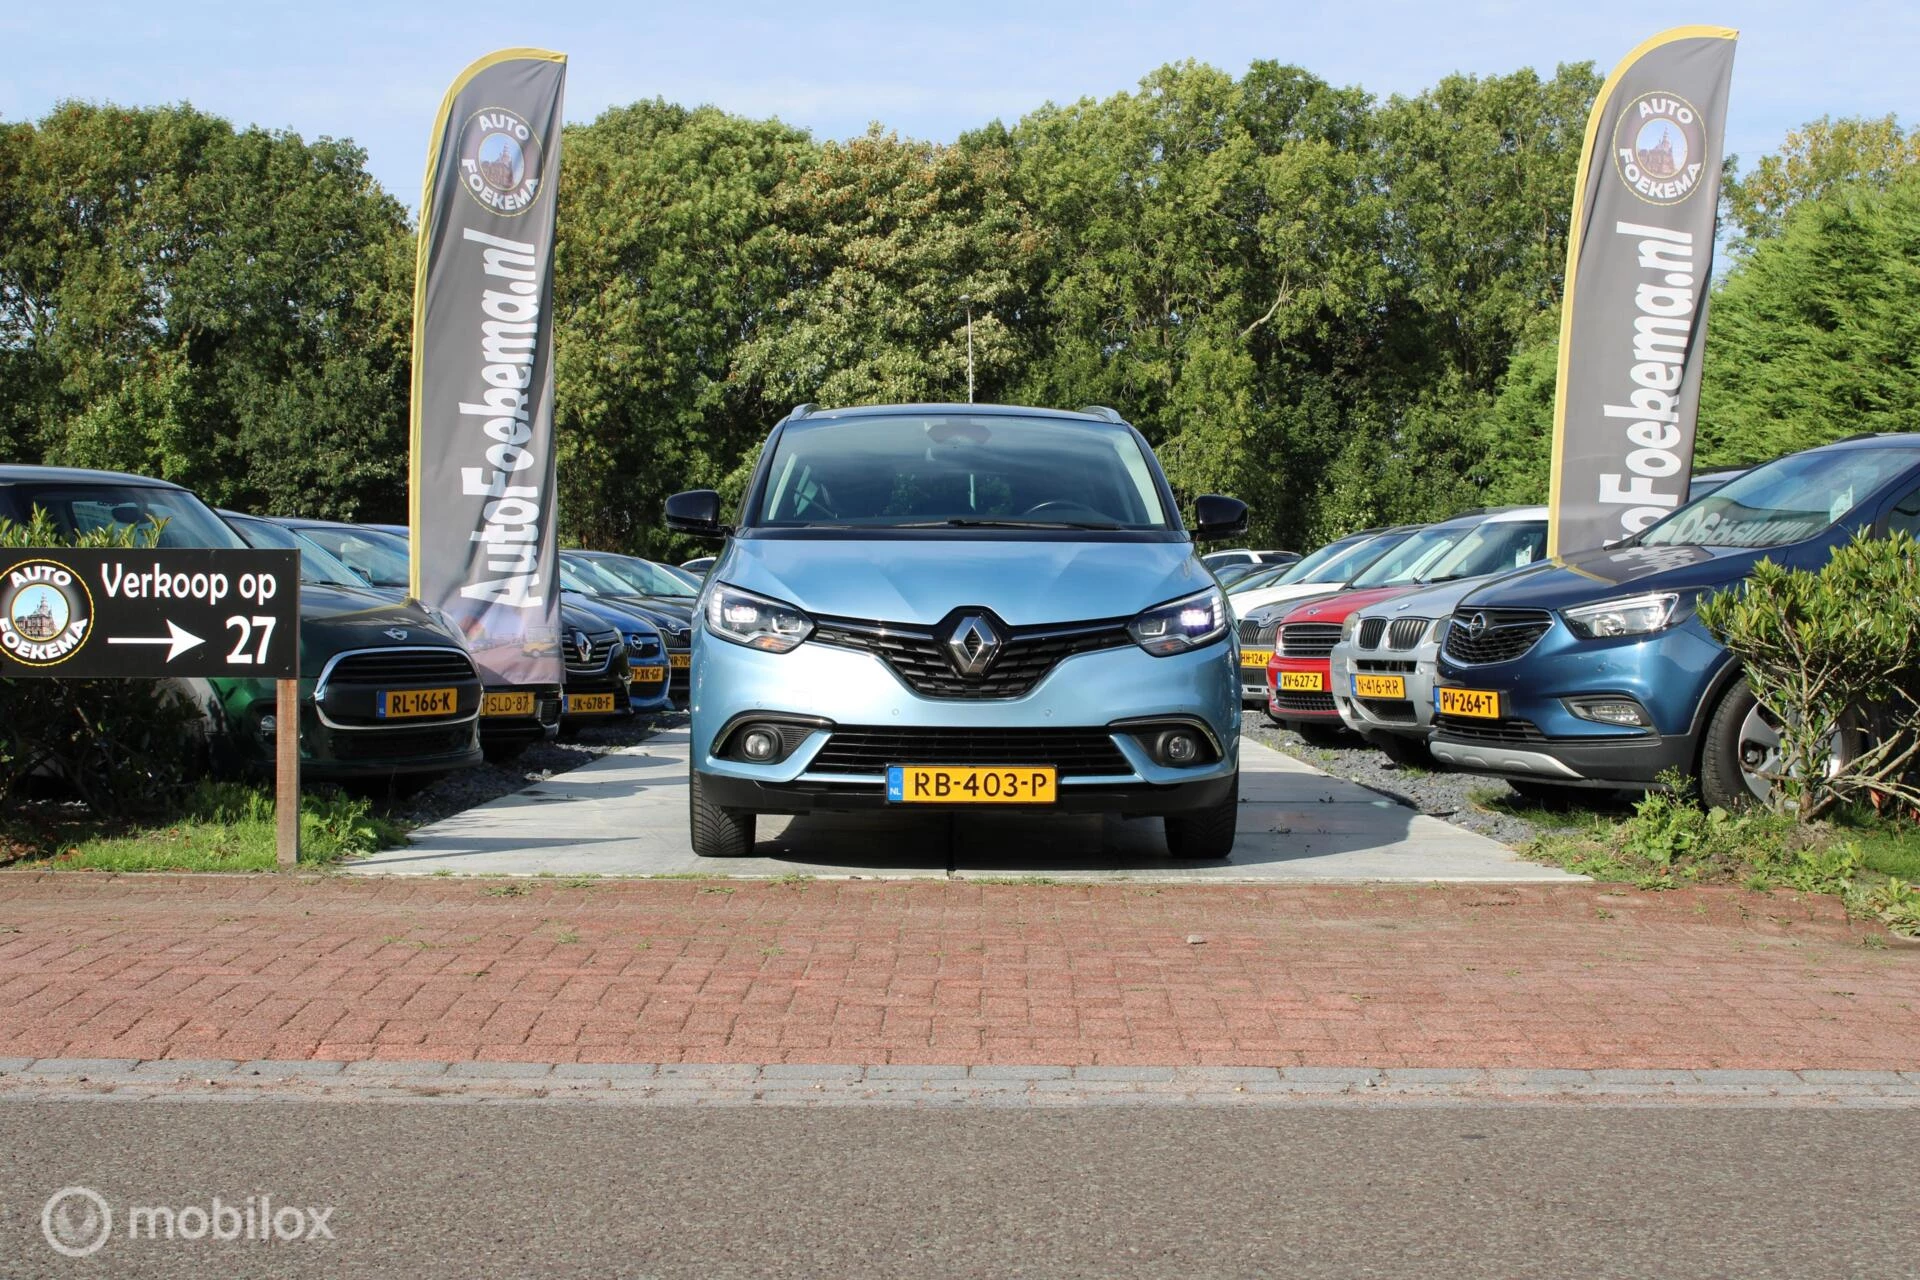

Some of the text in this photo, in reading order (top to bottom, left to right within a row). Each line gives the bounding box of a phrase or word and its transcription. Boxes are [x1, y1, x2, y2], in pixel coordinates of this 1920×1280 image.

[1639, 98, 1693, 124] AUTO
[479, 113, 529, 140] AUTO
[462, 158, 538, 210] FOEKEMA
[1619, 148, 1701, 198] FOEKEMA
[1598, 221, 1693, 547] oFoekema.nl
[459, 227, 544, 608] AutoFoekema.nl
[10, 565, 72, 589] AUTO
[101, 562, 277, 606] Verkoop op
[0, 617, 88, 660] FOEKEMA
[225, 615, 277, 664] 27
[1283, 672, 1318, 688] XV-627-Z
[1358, 679, 1399, 695] N-416-RR
[392, 693, 450, 714] RL-166-K
[573, 696, 611, 711] JK-678-F
[1442, 691, 1493, 714] PV-264-T
[889, 787, 902, 796] NL
[914, 772, 1047, 797] RB-403-P
